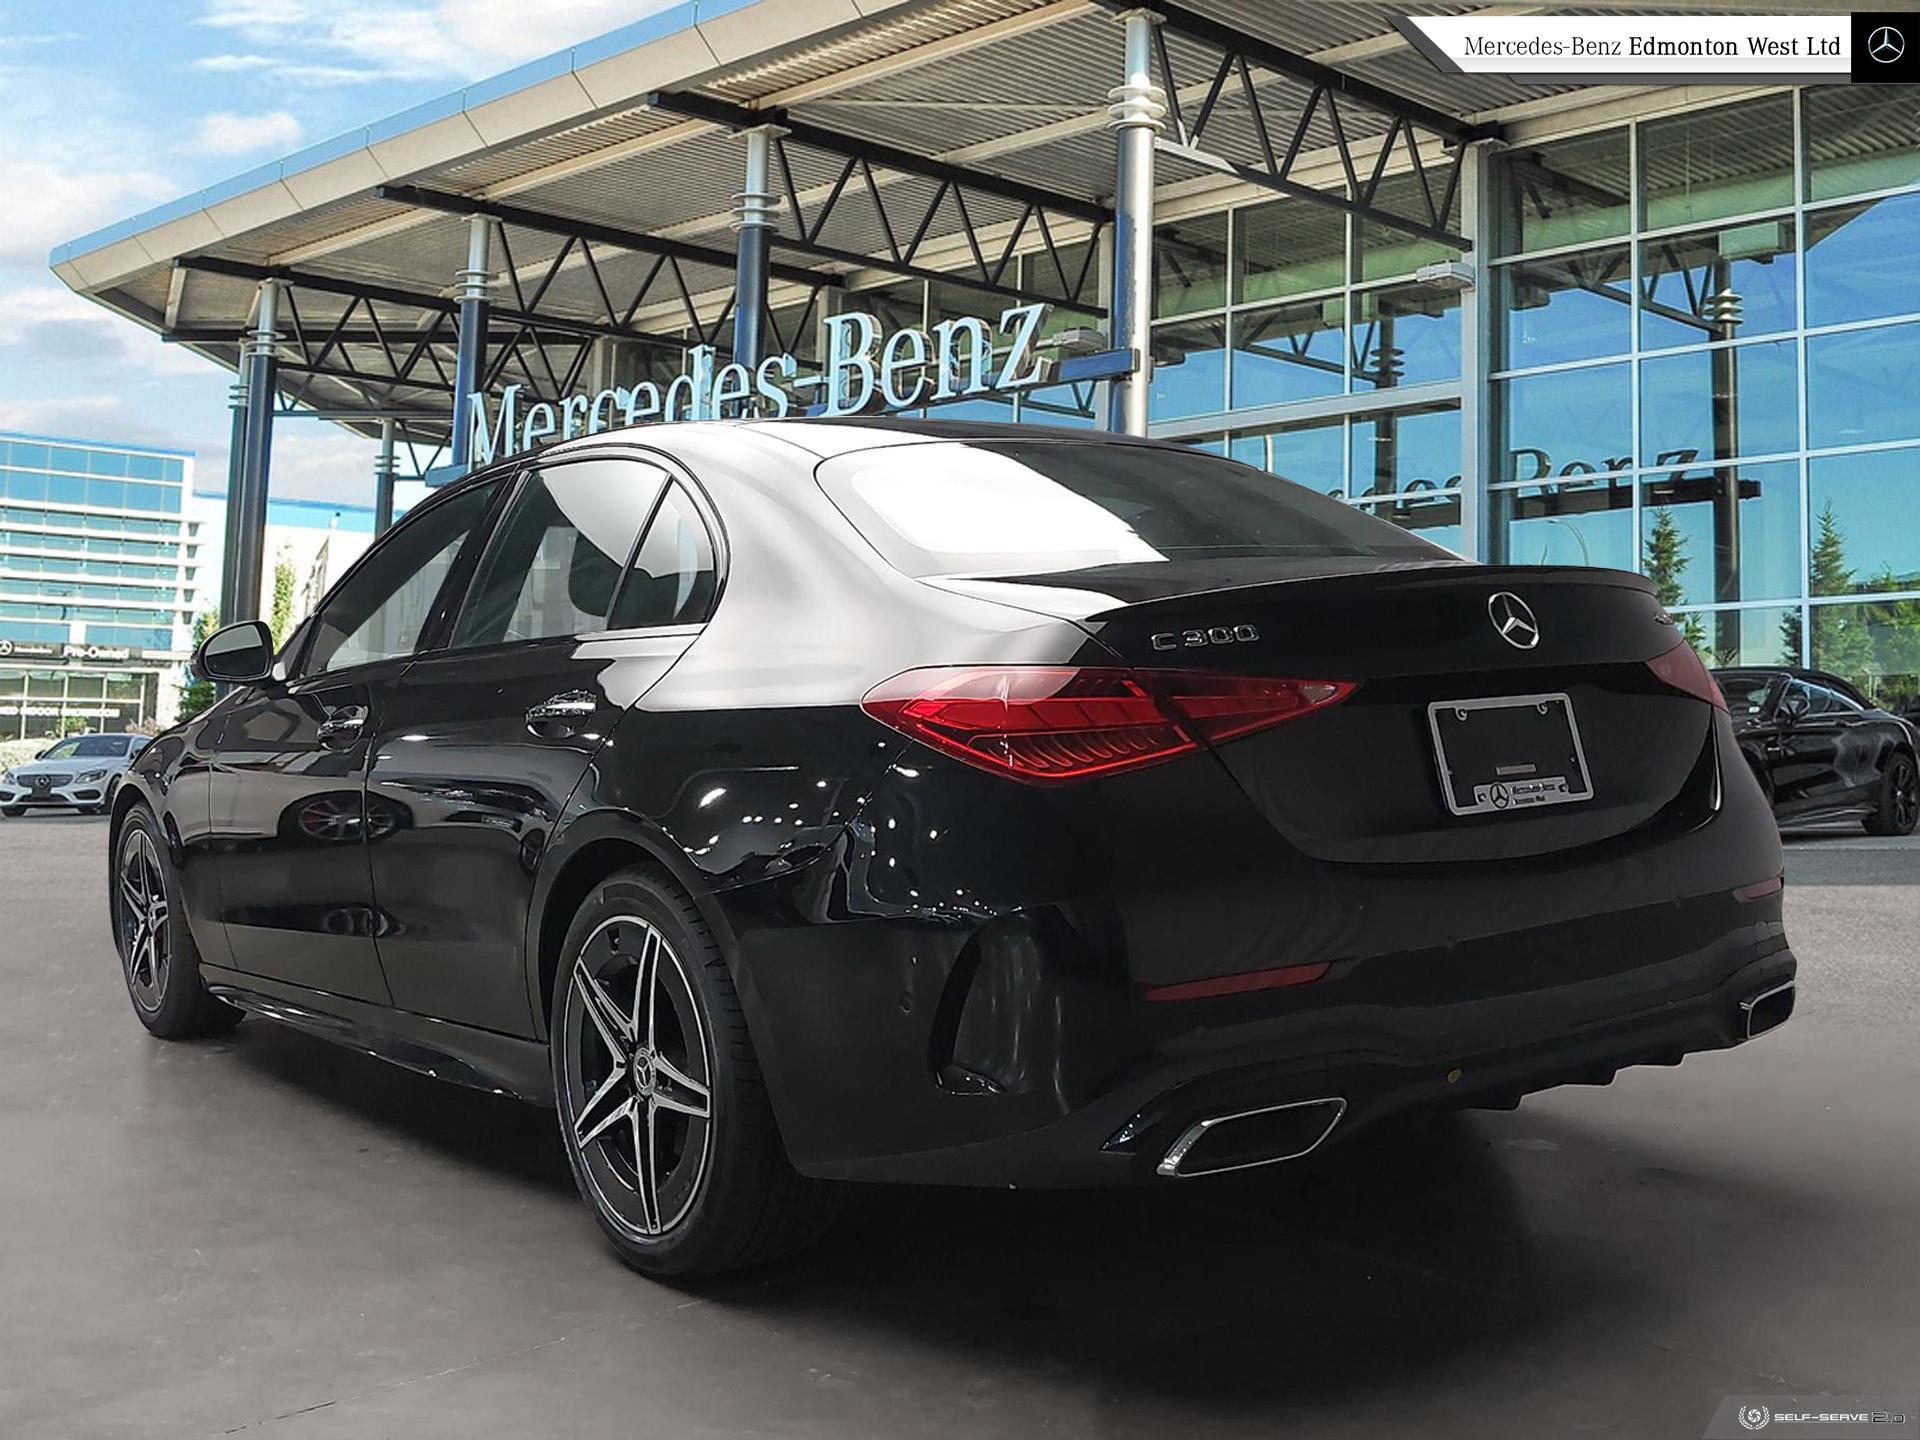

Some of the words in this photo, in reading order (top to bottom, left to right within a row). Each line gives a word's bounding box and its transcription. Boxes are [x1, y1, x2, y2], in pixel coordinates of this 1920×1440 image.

[467, 303, 1054, 474] Mercedes-Benz
[1151, 632, 1178, 651] C
[1182, 624, 1260, 647] 300
